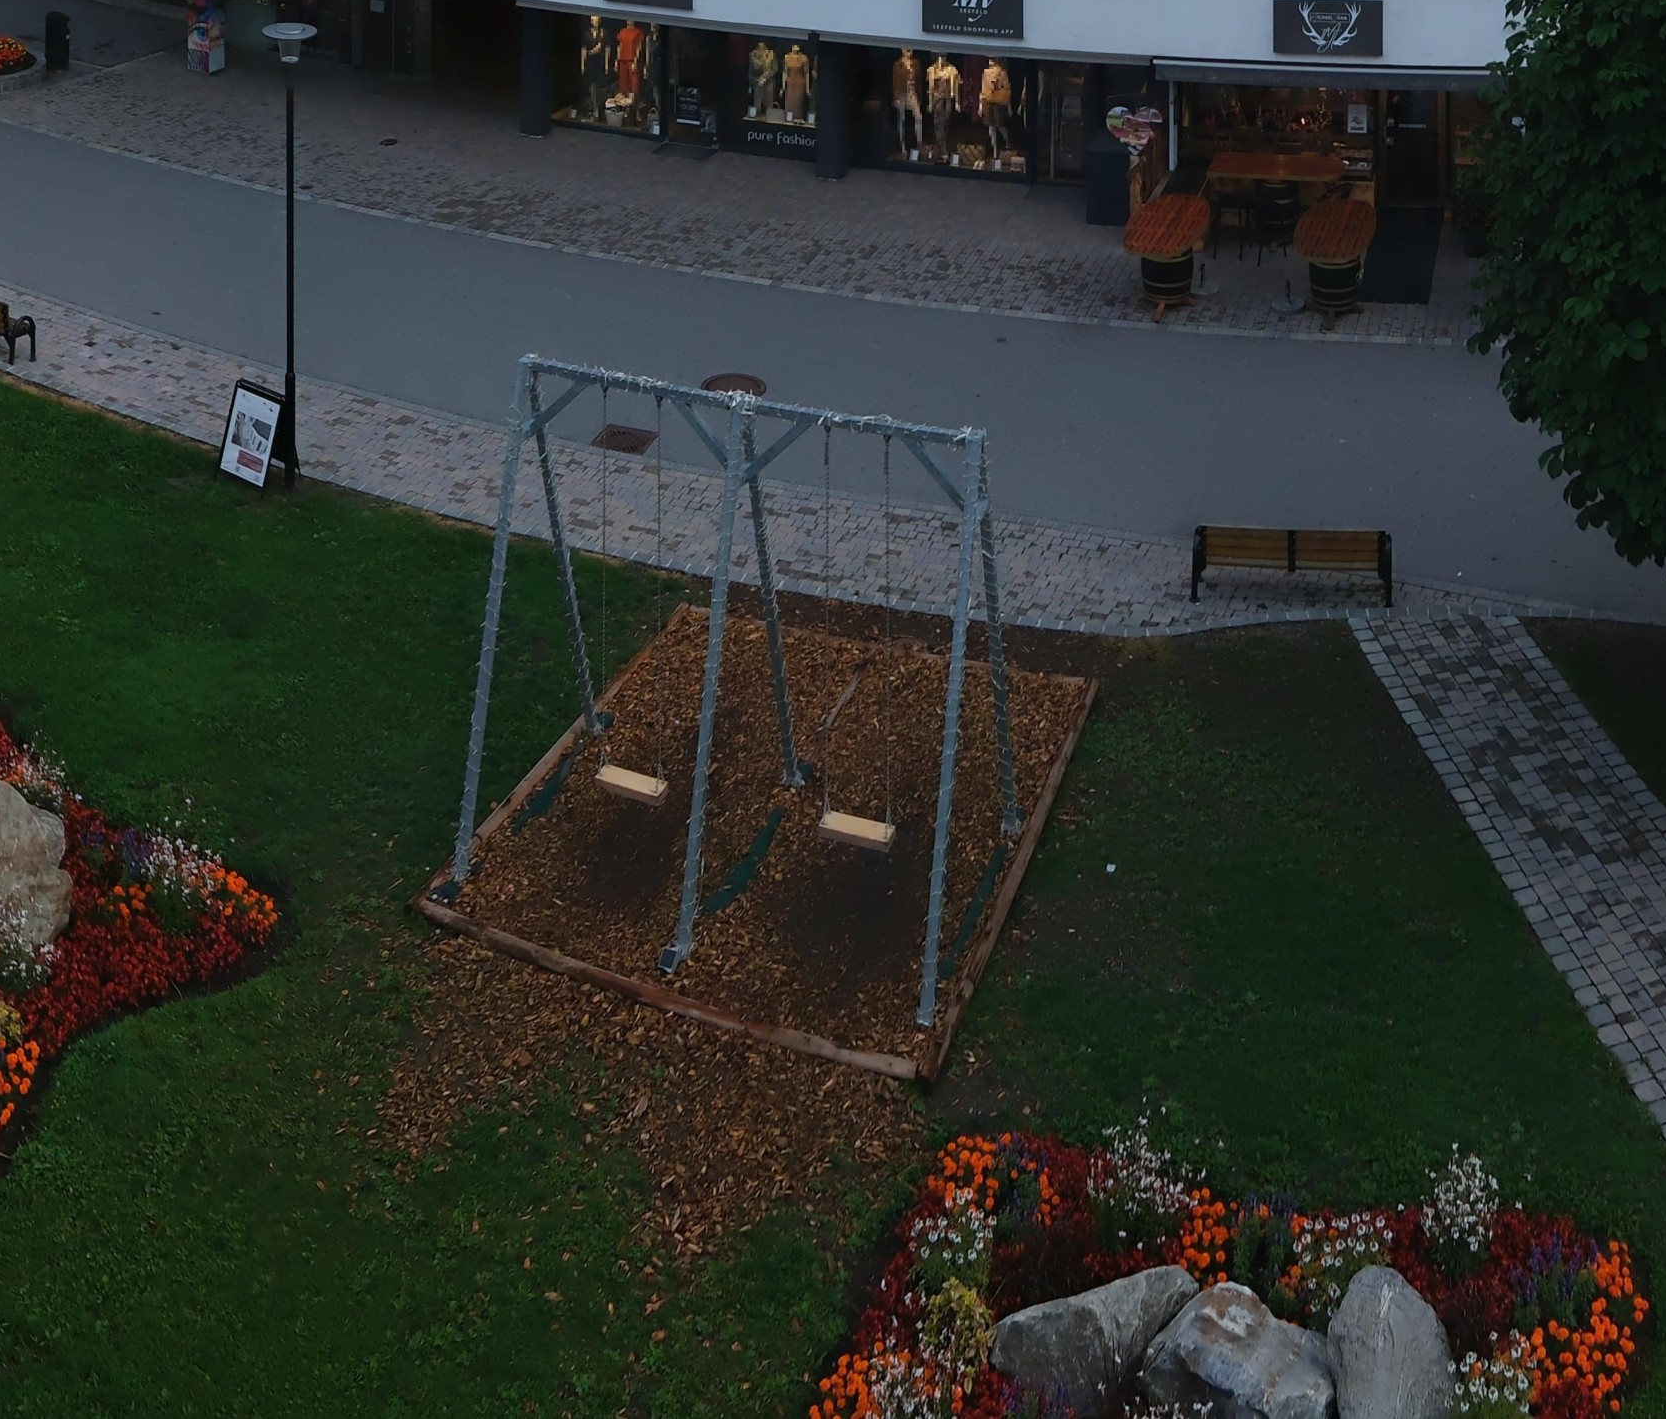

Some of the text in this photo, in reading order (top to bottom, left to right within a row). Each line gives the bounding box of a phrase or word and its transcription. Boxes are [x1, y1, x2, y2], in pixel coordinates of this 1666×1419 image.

[933, 23, 961, 31] SEEFELD
[963, 26, 999, 34] SHOPPING
[747, 131, 773, 142] pure
